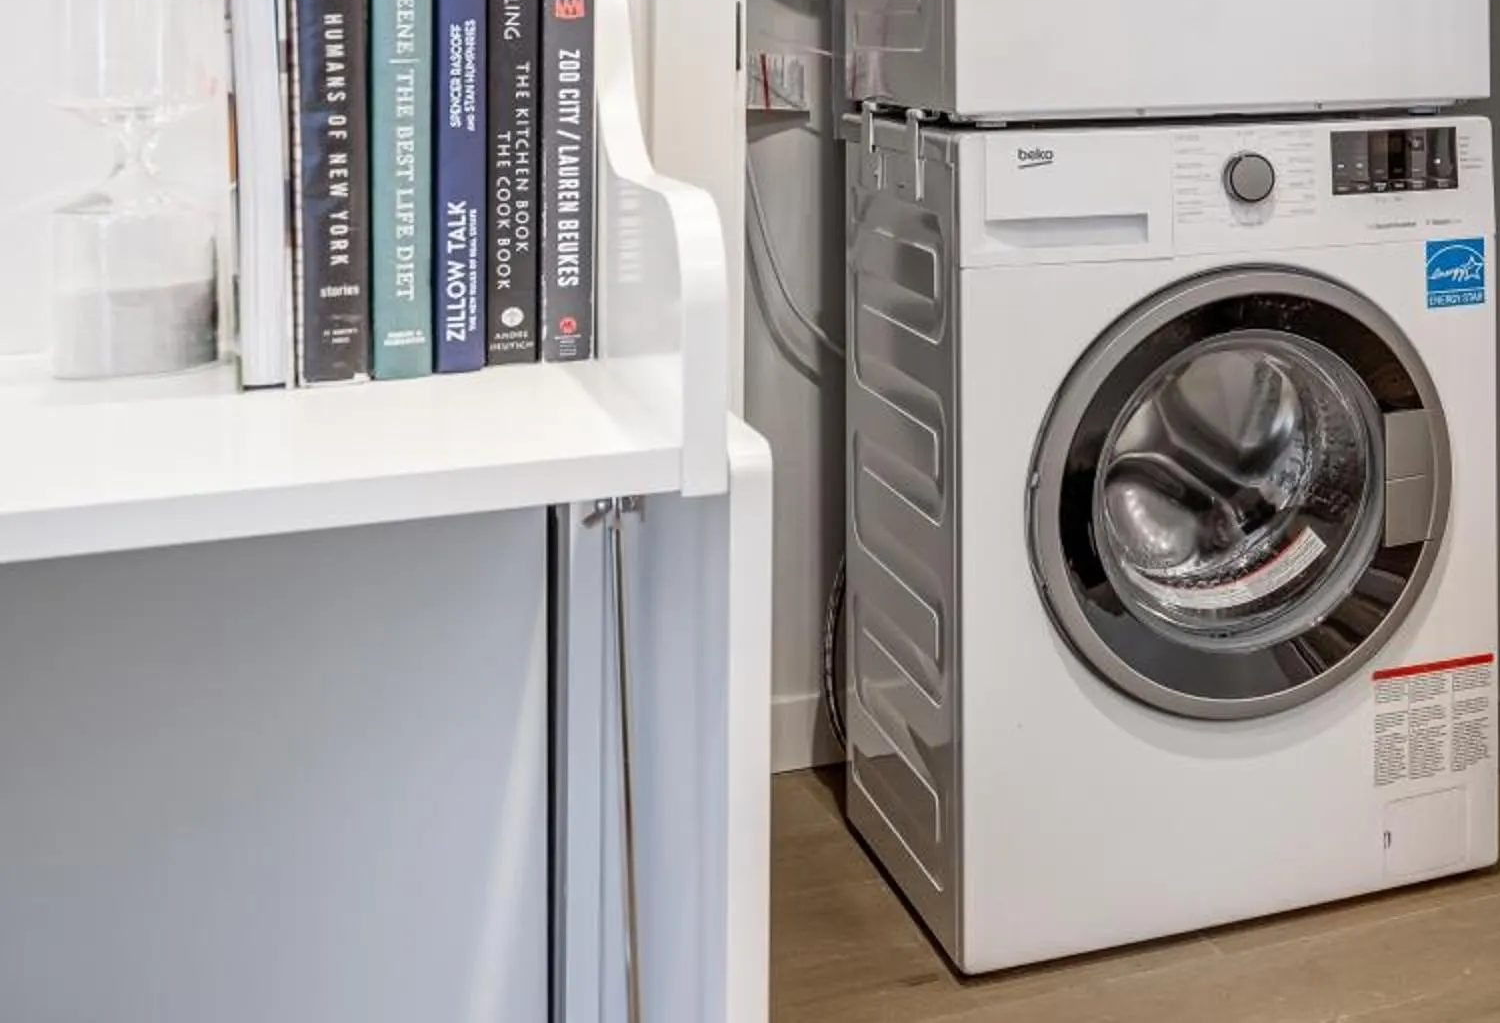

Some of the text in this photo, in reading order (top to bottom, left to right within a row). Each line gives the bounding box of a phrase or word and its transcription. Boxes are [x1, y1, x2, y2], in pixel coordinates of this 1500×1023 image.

[449, 24, 463, 128] SPENCER RASCOFF
[464, 19, 477, 82] HUMPHRIES
[558, 49, 581, 83] ZOO
[395, 68, 416, 119] THE
[463, 84, 476, 113] STAN
[558, 88, 581, 125] CITY
[323, 12, 350, 266] HUMANS OF NEW YORK
[395, 125, 416, 182] BEST
[515, 60, 530, 252] THE KITCHEN BOOK
[1017, 147, 1055, 162] beko
[557, 145, 581, 214] LAUREN
[395, 188, 416, 240] LIFE
[496, 130, 511, 290] THE COOK BOOK
[395, 244, 416, 302] DIET
[446, 200, 467, 342] ZILLOW TALK
[557, 219, 580, 288] BEUKES
[320, 284, 360, 298] stories
